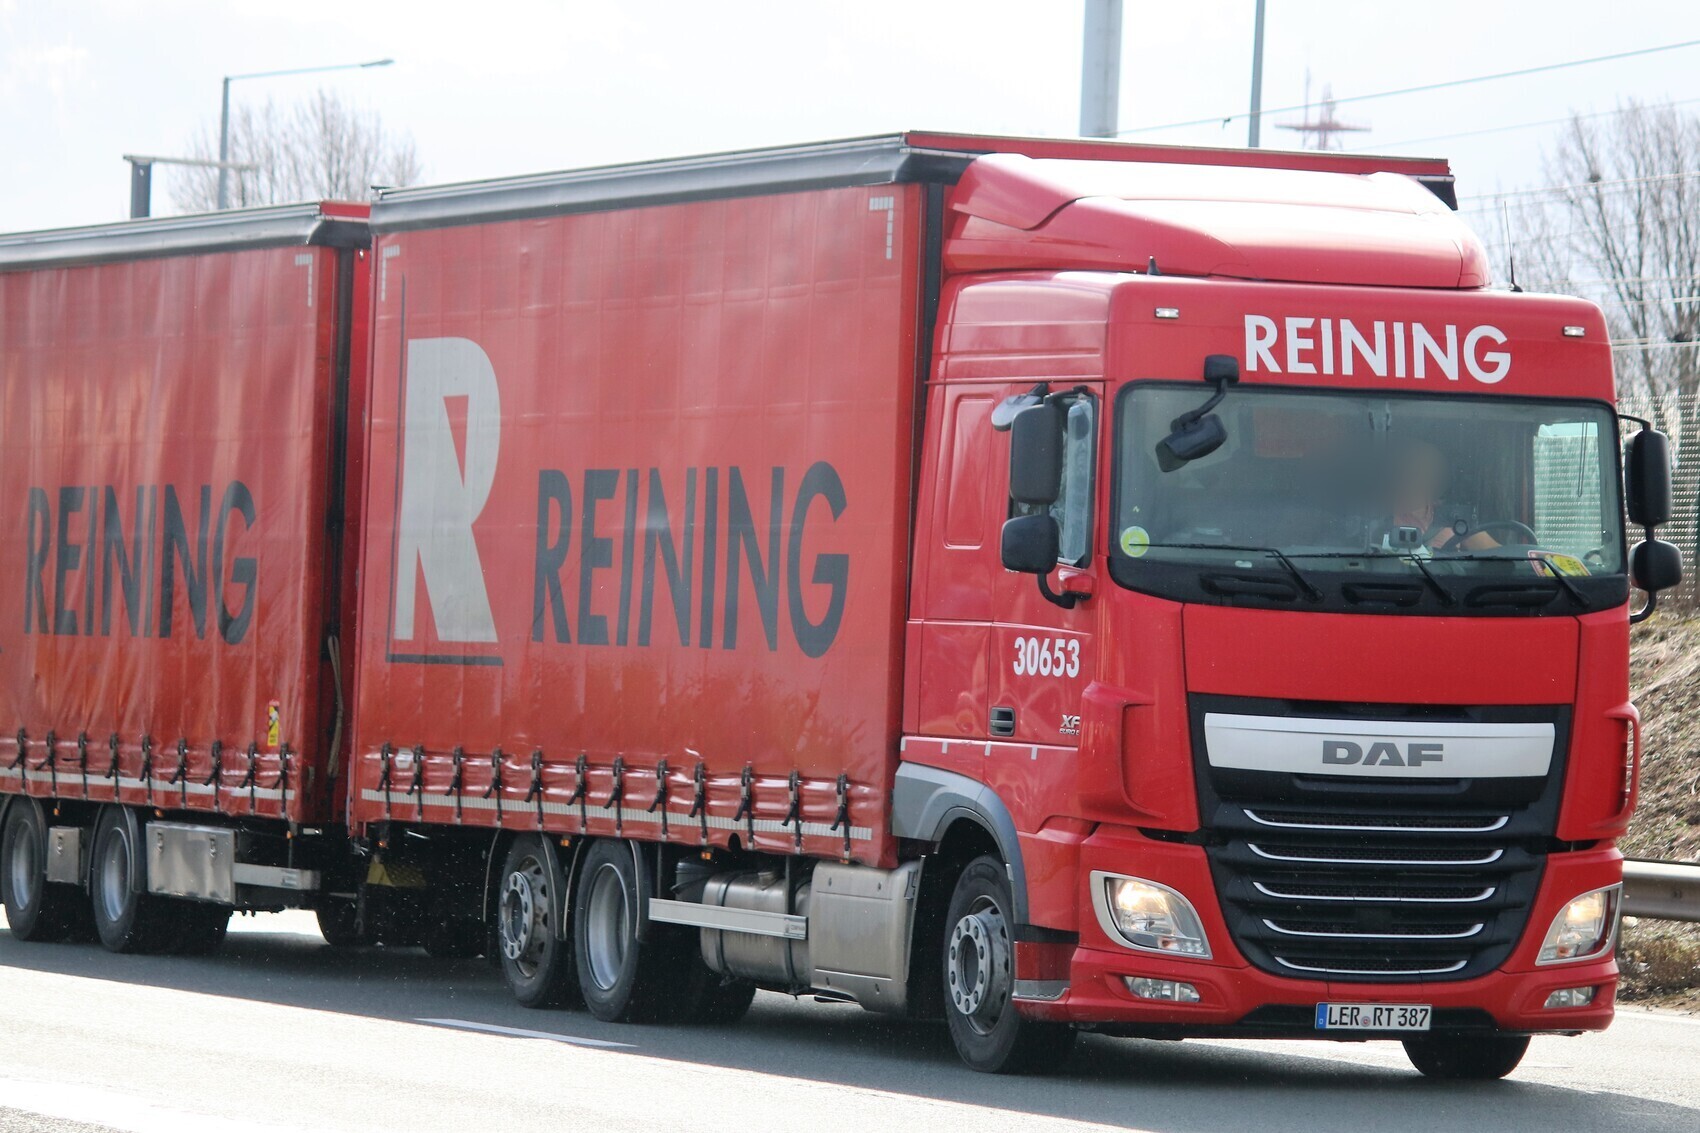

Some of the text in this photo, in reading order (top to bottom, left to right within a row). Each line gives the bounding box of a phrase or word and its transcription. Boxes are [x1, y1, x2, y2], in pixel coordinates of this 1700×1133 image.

[1244, 314, 1511, 384] REINING
[394, 336, 501, 643] R
[24, 480, 257, 645] REINING
[532, 461, 849, 658] REINING
[1013, 636, 1081, 678] 30653
[1060, 714, 1081, 728] XF
[1322, 740, 1444, 767] DAF
[1328, 1006, 1429, 1027] LER RT 387
